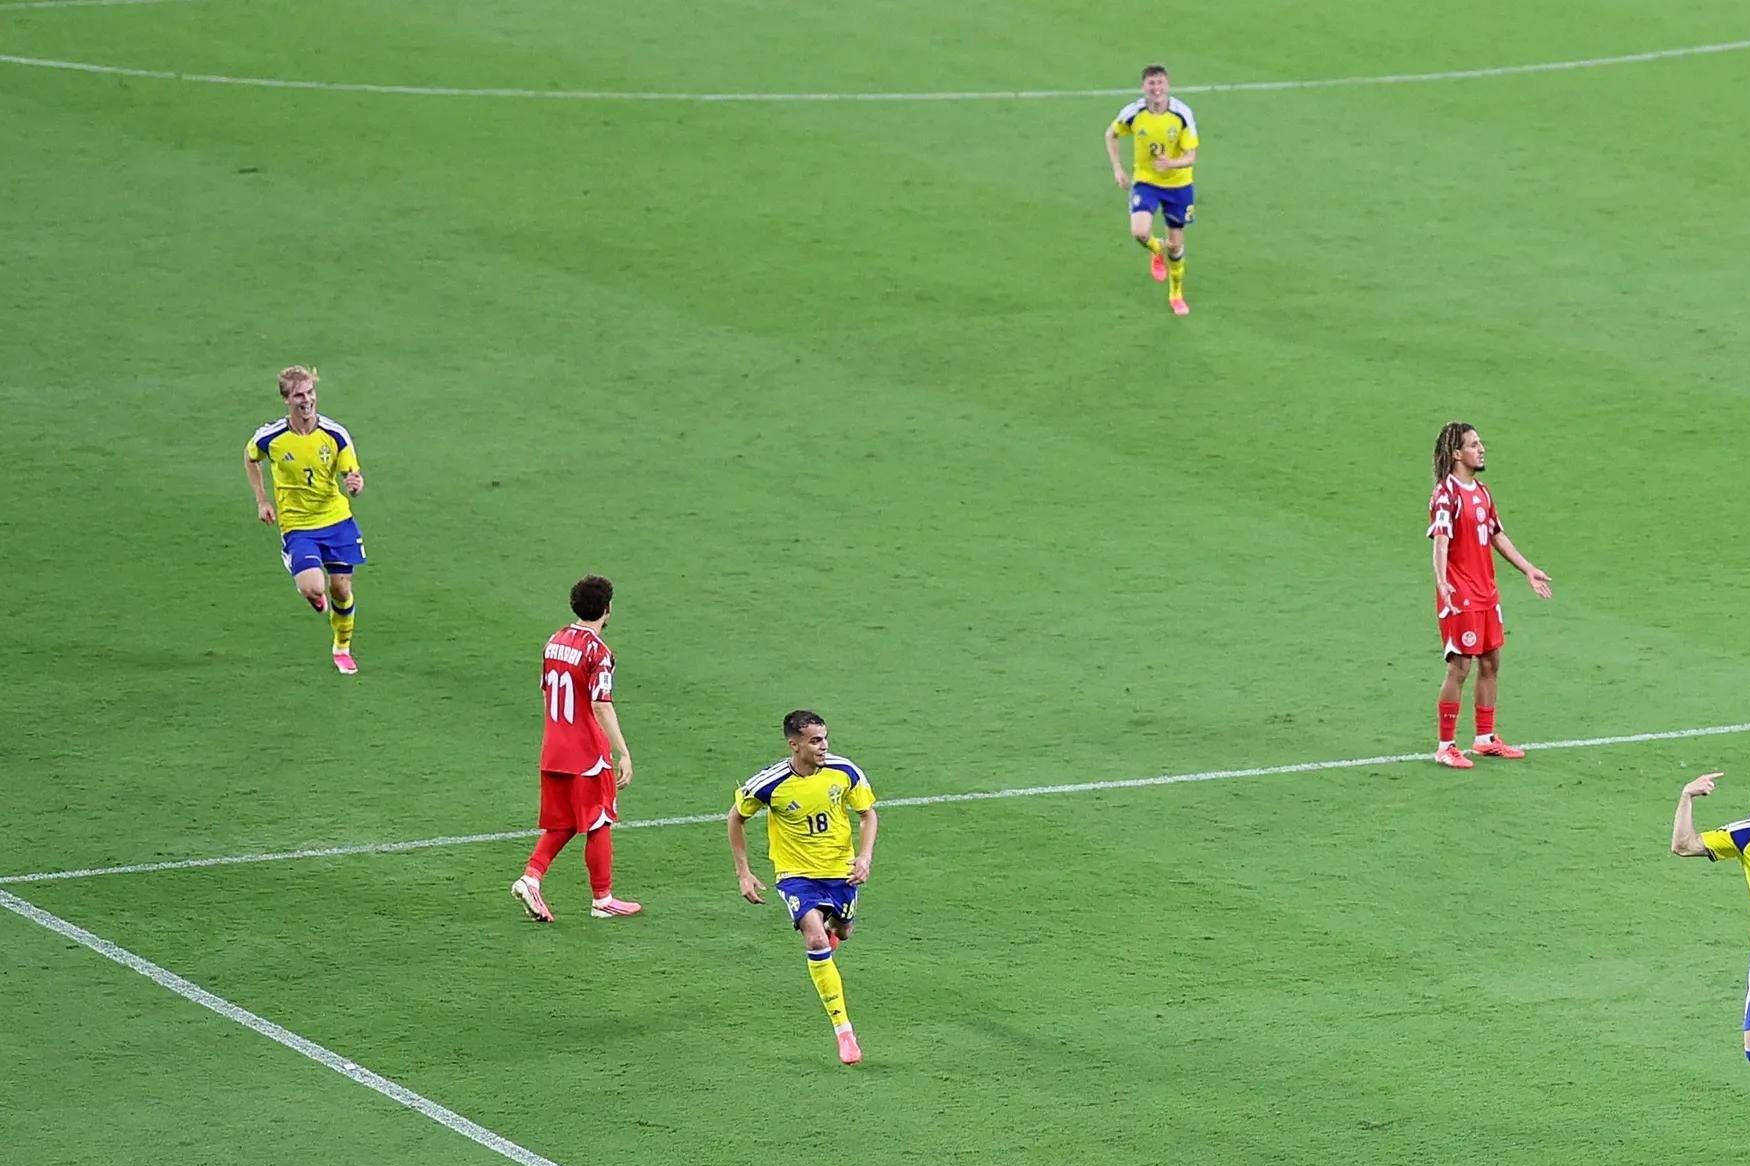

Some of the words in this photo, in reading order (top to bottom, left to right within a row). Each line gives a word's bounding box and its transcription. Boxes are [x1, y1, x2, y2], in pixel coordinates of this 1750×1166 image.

[303, 469, 314, 487] 7
[1476, 522, 1489, 547] 10
[545, 669, 575, 725] 11
[807, 812, 829, 837] 18
